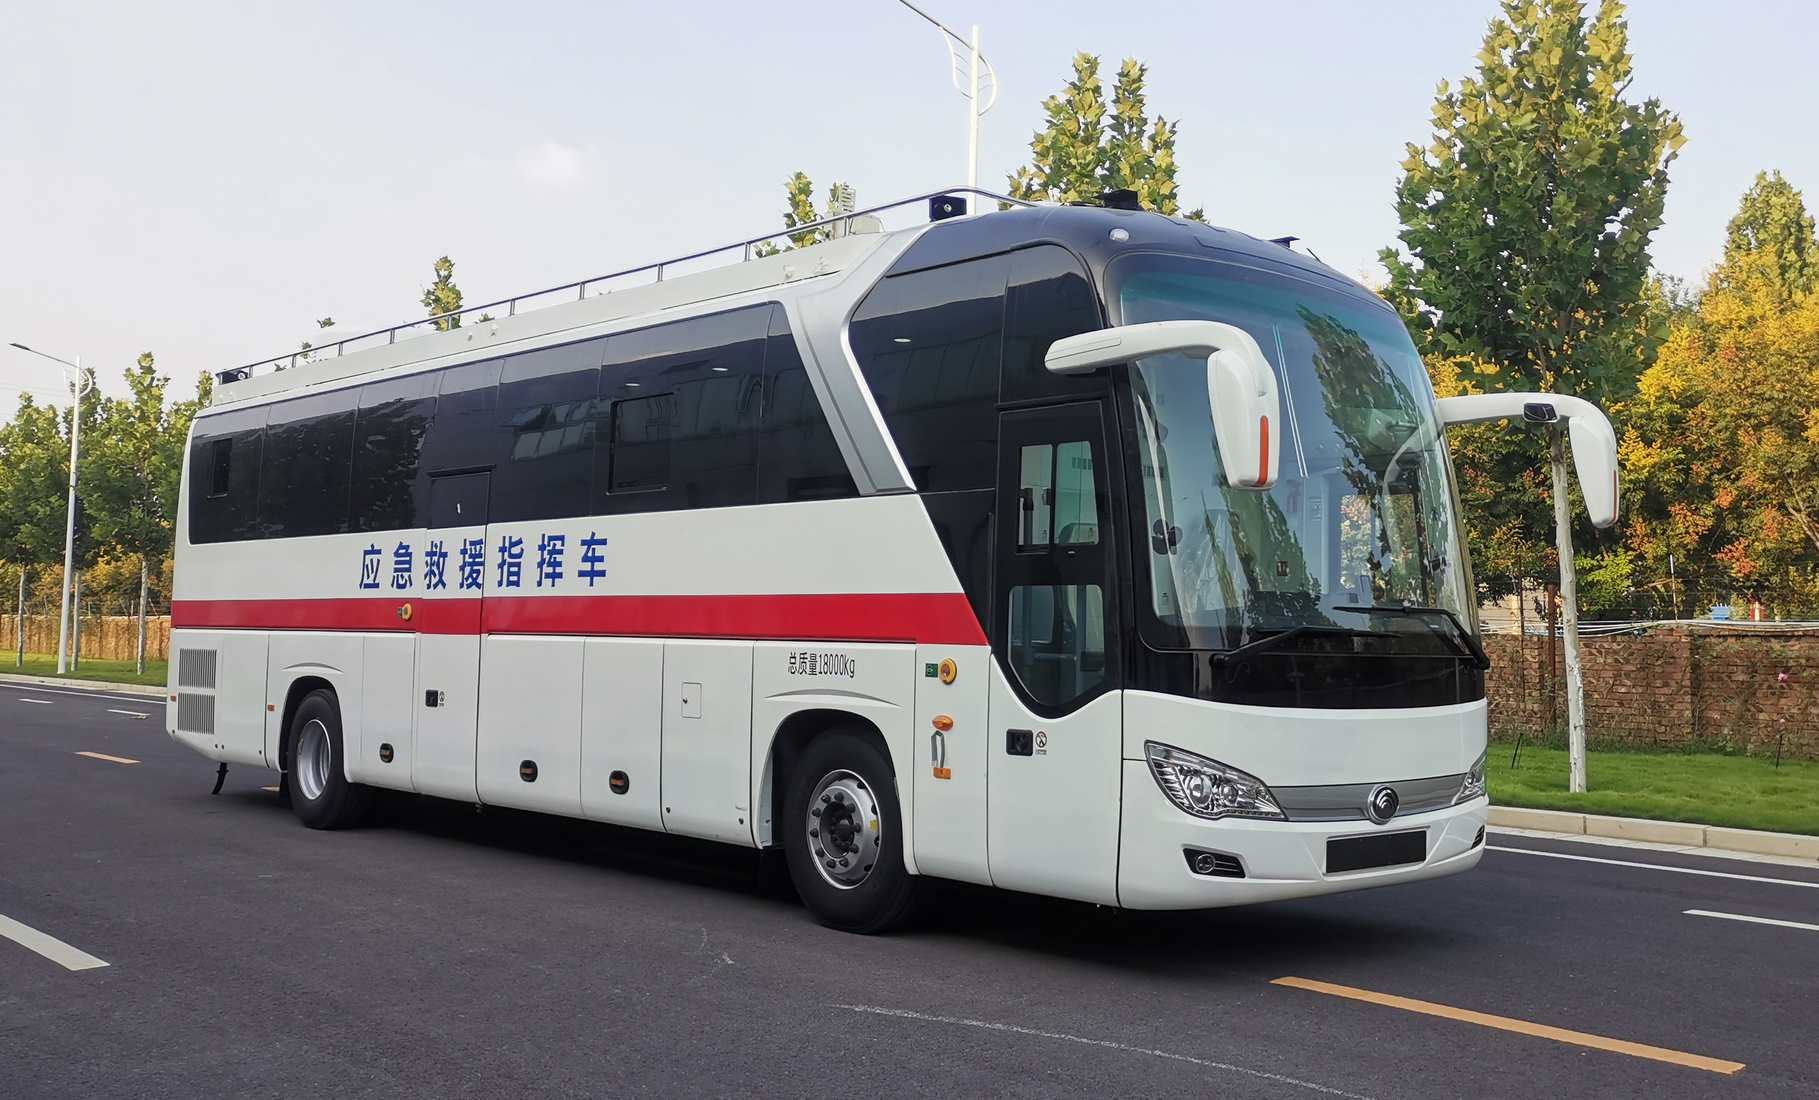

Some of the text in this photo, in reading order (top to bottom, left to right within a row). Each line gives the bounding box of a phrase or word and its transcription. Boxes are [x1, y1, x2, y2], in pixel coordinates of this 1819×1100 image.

[359, 531, 608, 590] 应急救援指挥车
